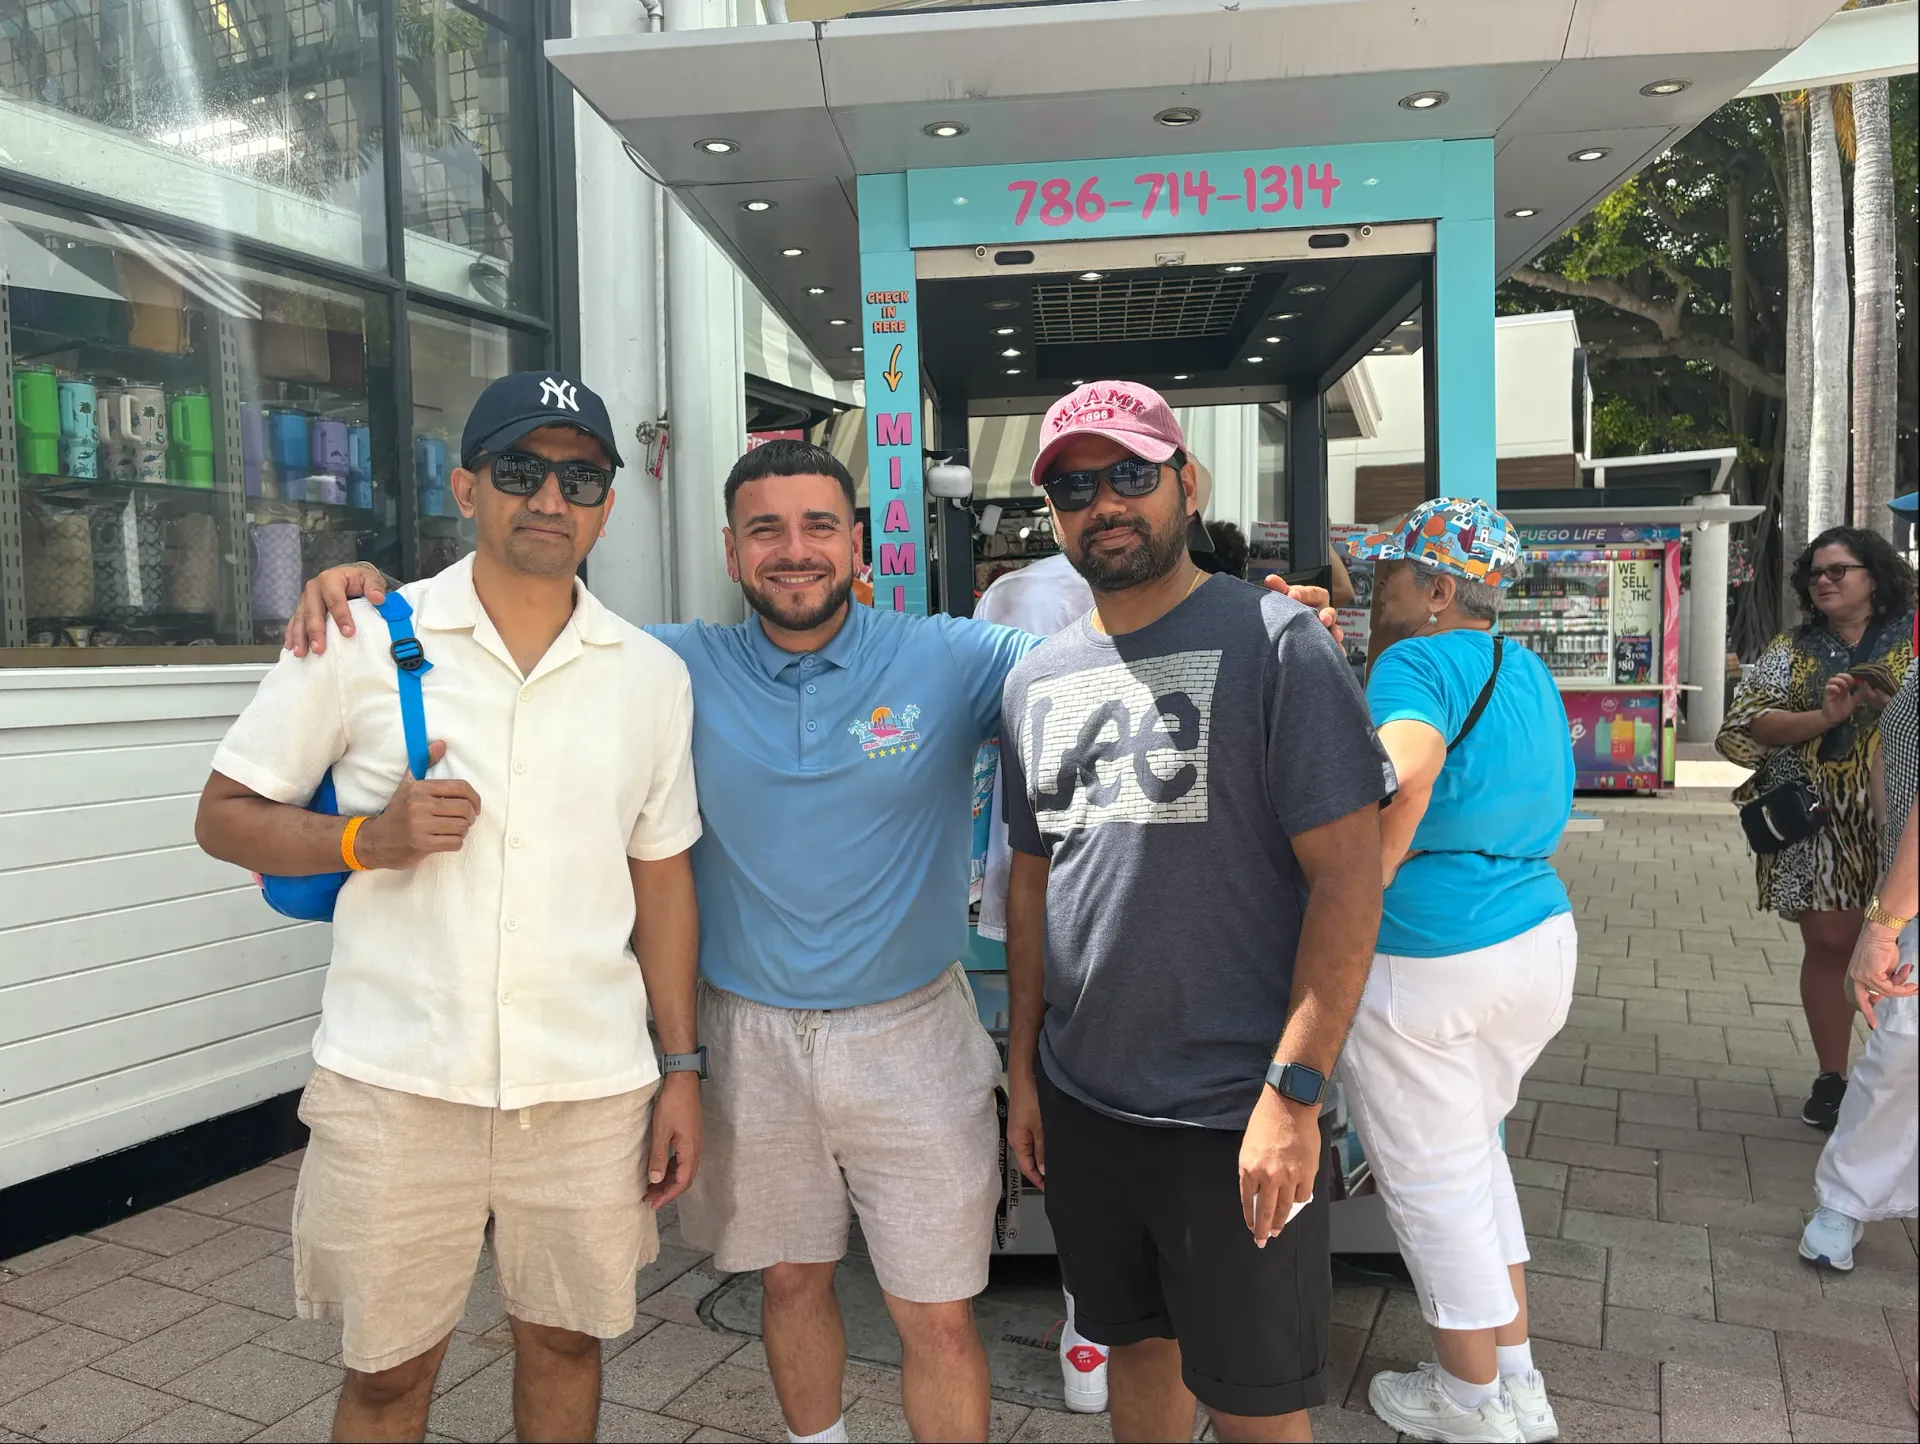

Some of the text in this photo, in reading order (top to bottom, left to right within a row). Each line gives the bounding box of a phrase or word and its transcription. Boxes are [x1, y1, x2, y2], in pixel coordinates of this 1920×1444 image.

[1007, 162, 1341, 227] 786-714-1314
[866, 291, 909, 304] CHECK
[881, 306, 896, 319] IN
[873, 320, 906, 333] HERE
[539, 377, 580, 412] NY
[1052, 389, 1147, 433] MIAMI
[1080, 410, 1109, 423] 1896
[876, 412, 916, 612] MIAMI
[1330, 525, 1367, 533] verglades
[1519, 529, 1607, 541] FUEGO LIFE
[1618, 563, 1636, 575] WE
[1622, 577, 1648, 588] SELL
[1631, 590, 1651, 601] THC
[1618, 660, 1634, 671] $80
[1030, 691, 1201, 810] Lee
[1009, 1168, 1019, 1211] CHANEL
